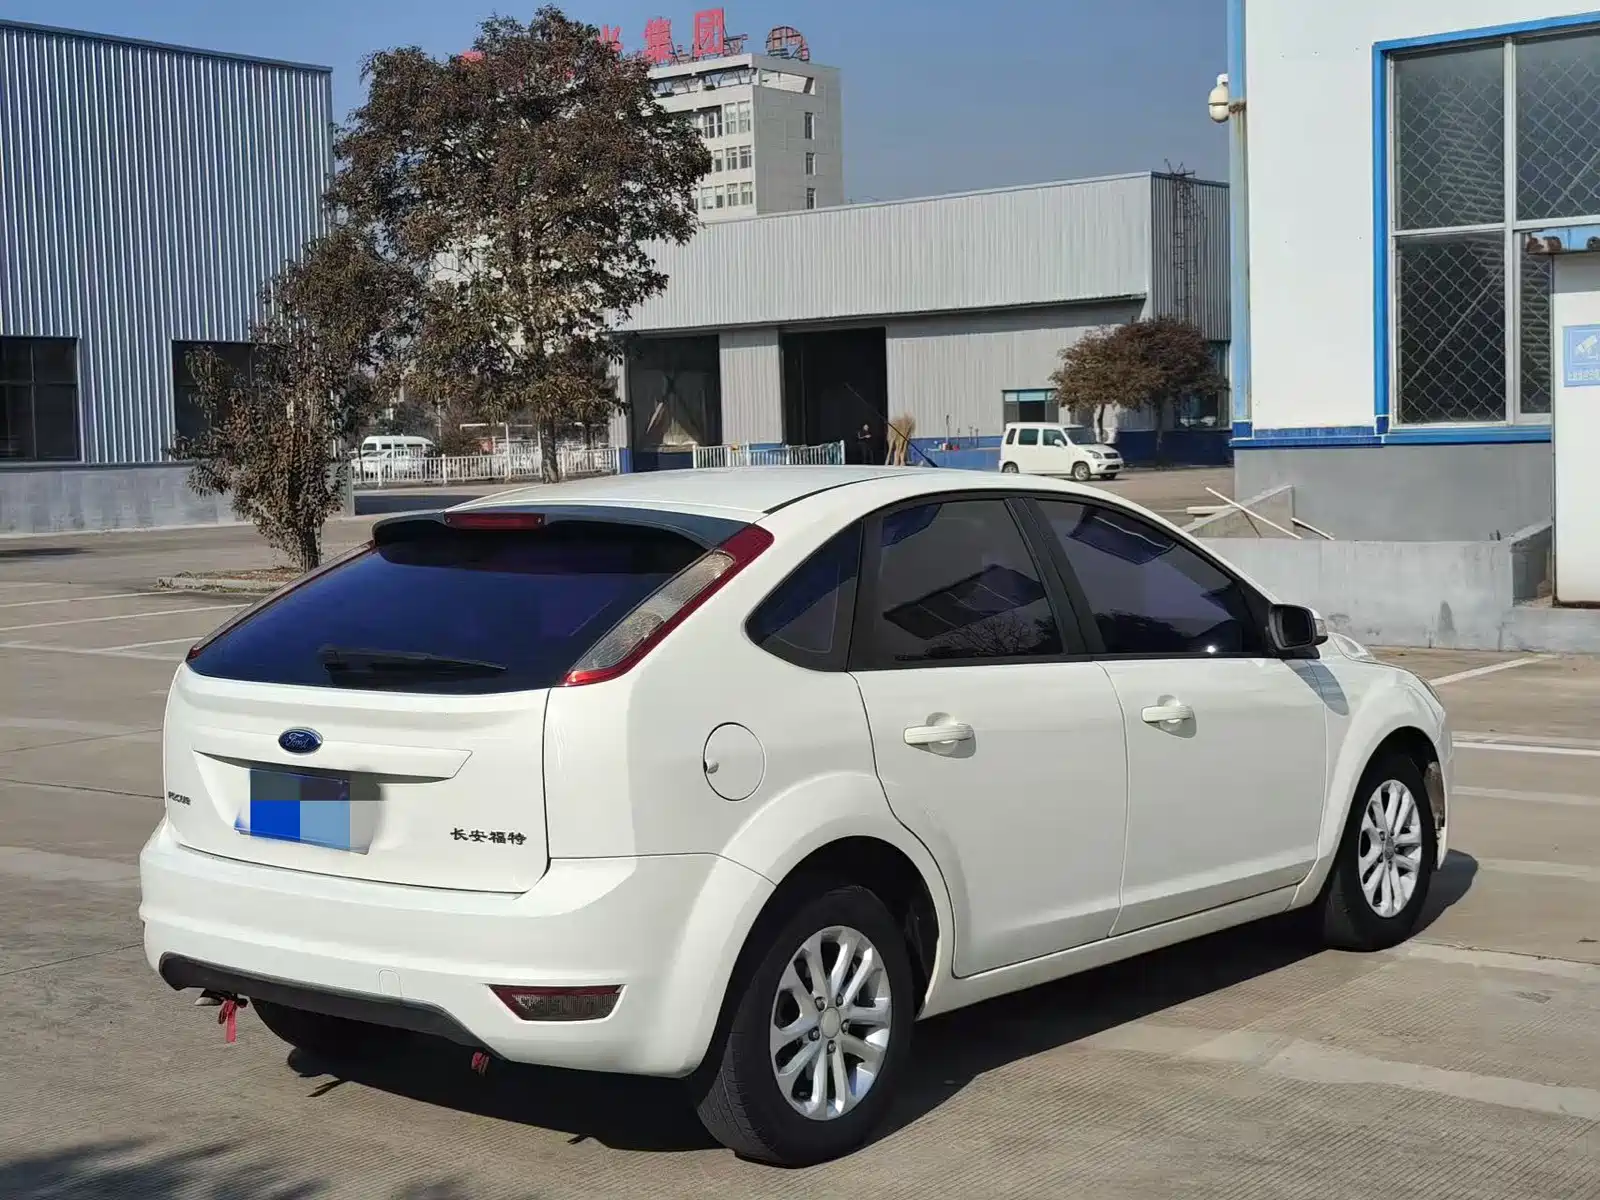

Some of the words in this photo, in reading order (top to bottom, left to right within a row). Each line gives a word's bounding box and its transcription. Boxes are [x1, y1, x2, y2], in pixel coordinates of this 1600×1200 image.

[283, 731, 313, 750] Ford
[450, 827, 527, 845] 长安福特
